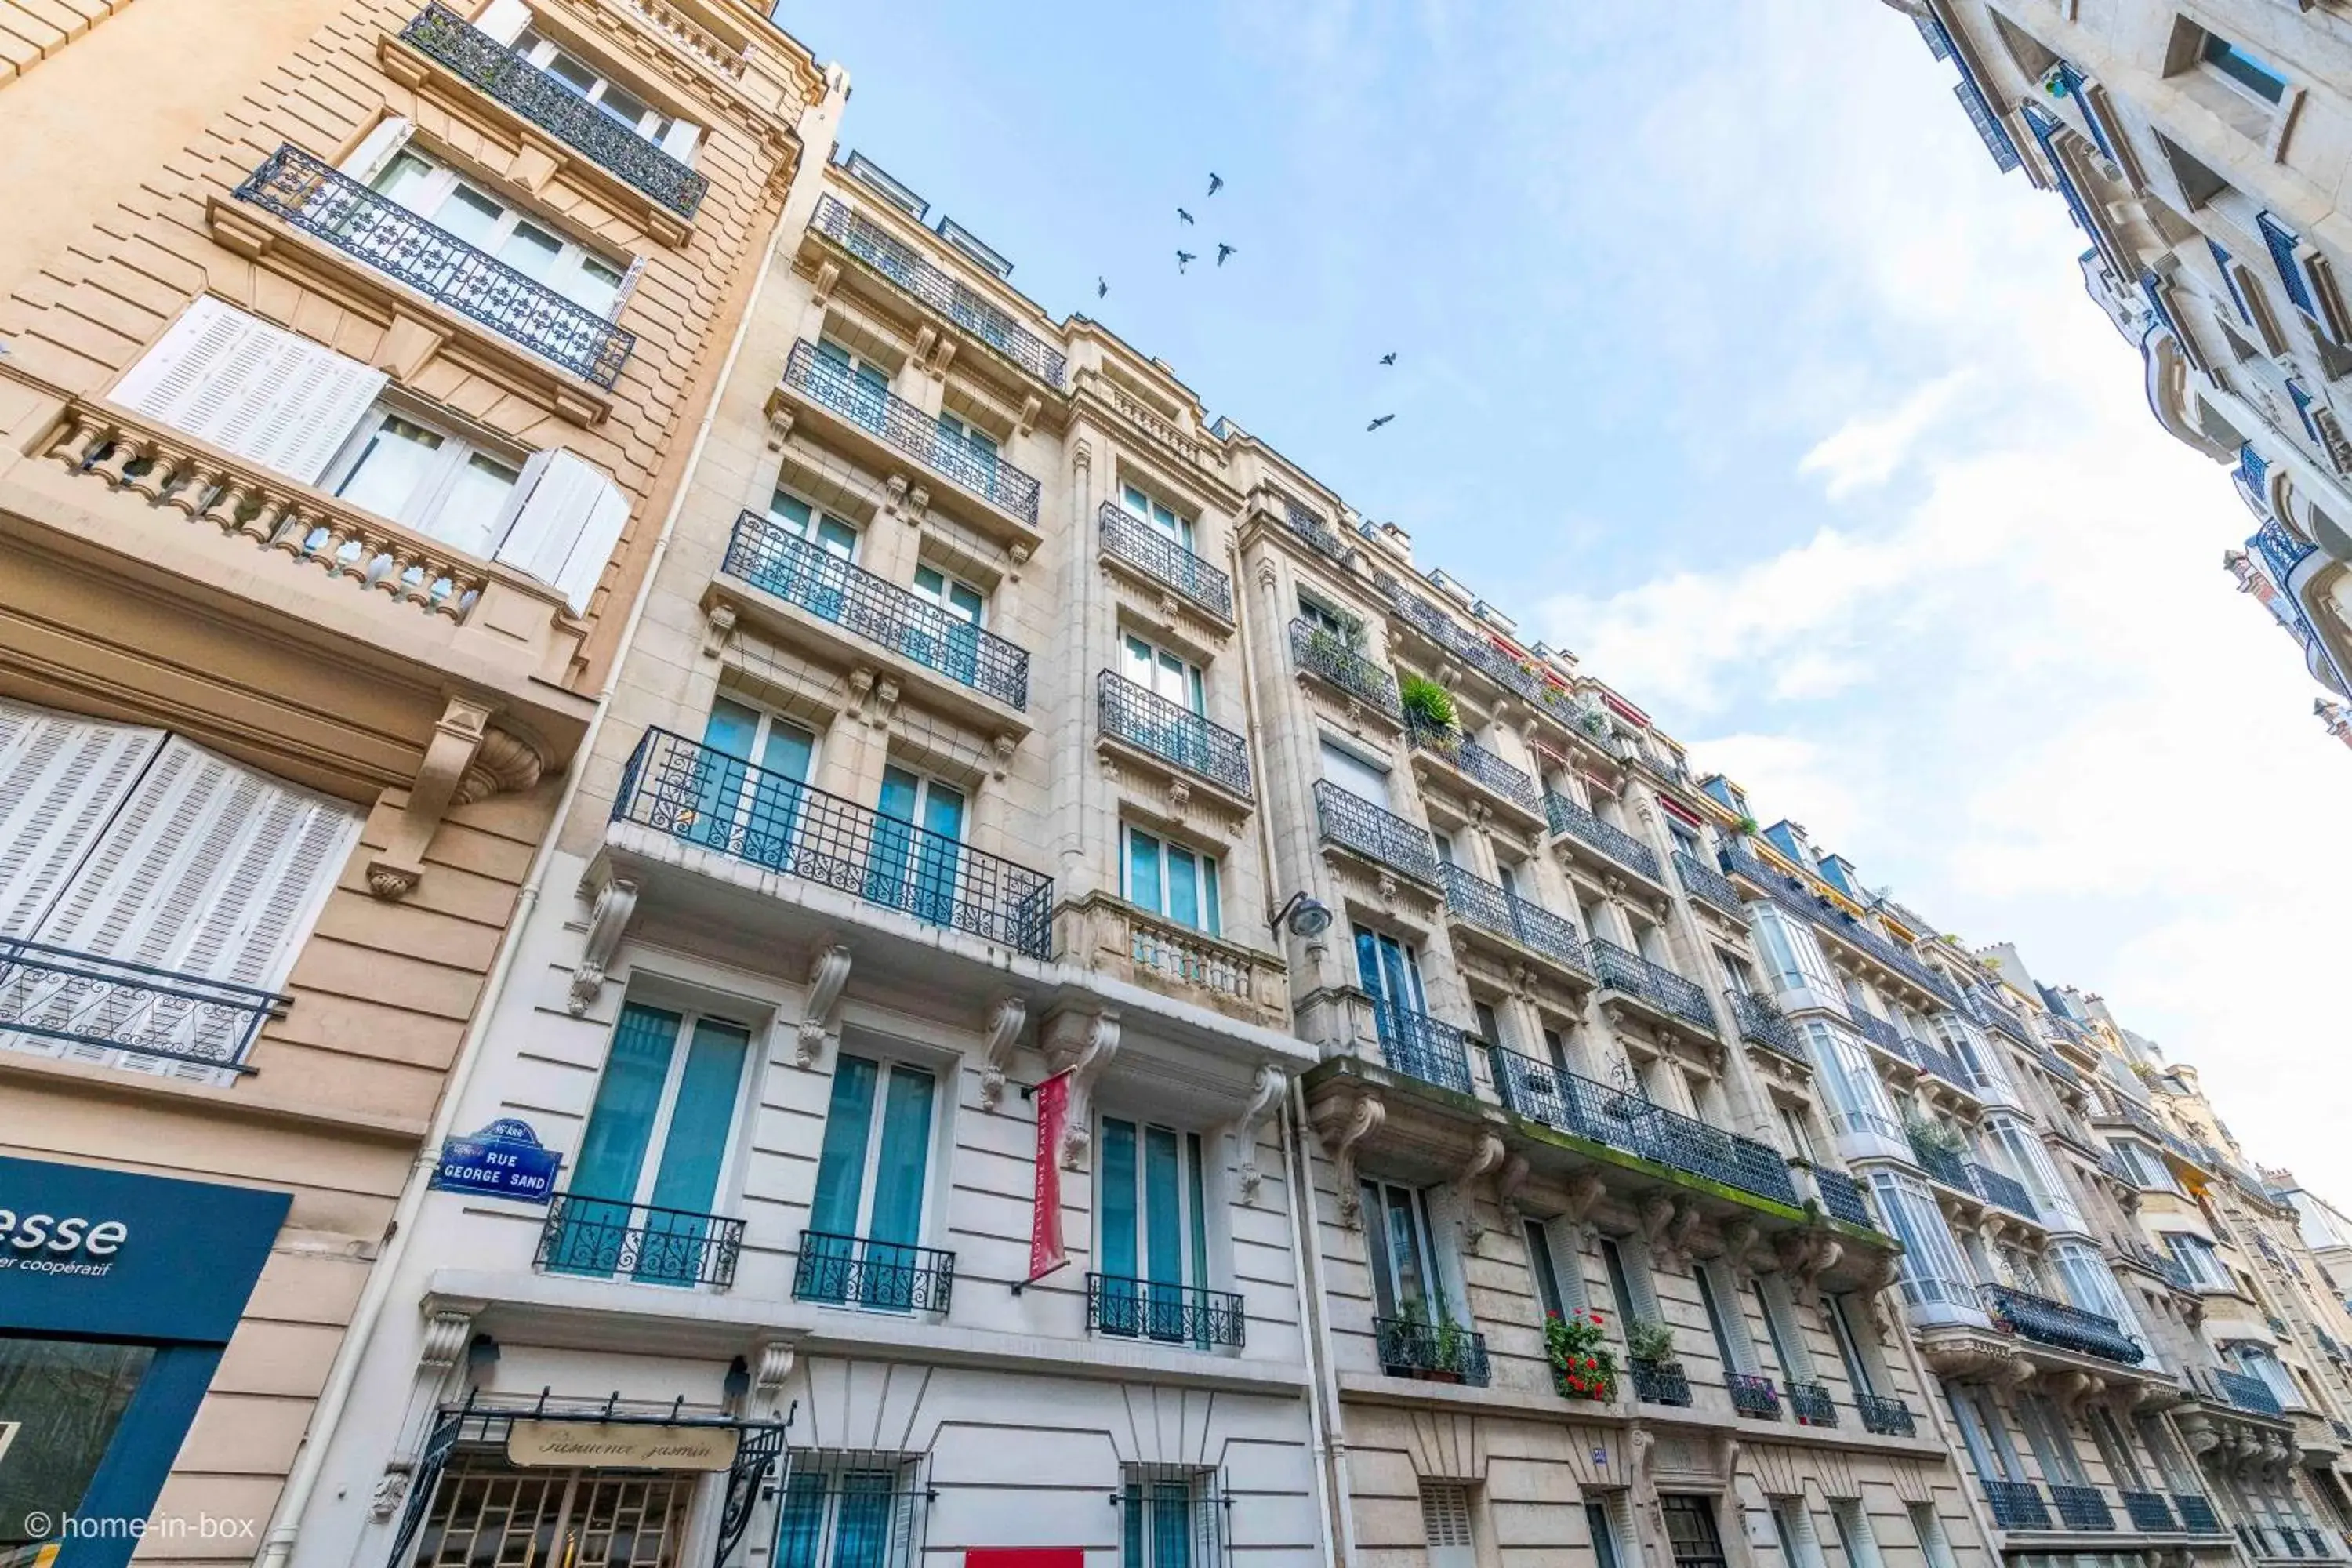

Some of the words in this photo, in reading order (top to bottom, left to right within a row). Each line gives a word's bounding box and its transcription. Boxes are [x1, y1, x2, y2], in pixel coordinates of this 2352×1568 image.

[486, 1152, 518, 1167] RUE
[445, 1166, 501, 1183] GEORGE
[510, 1174, 545, 1189] SAND
[20, 1259, 113, 1276] coopératif
